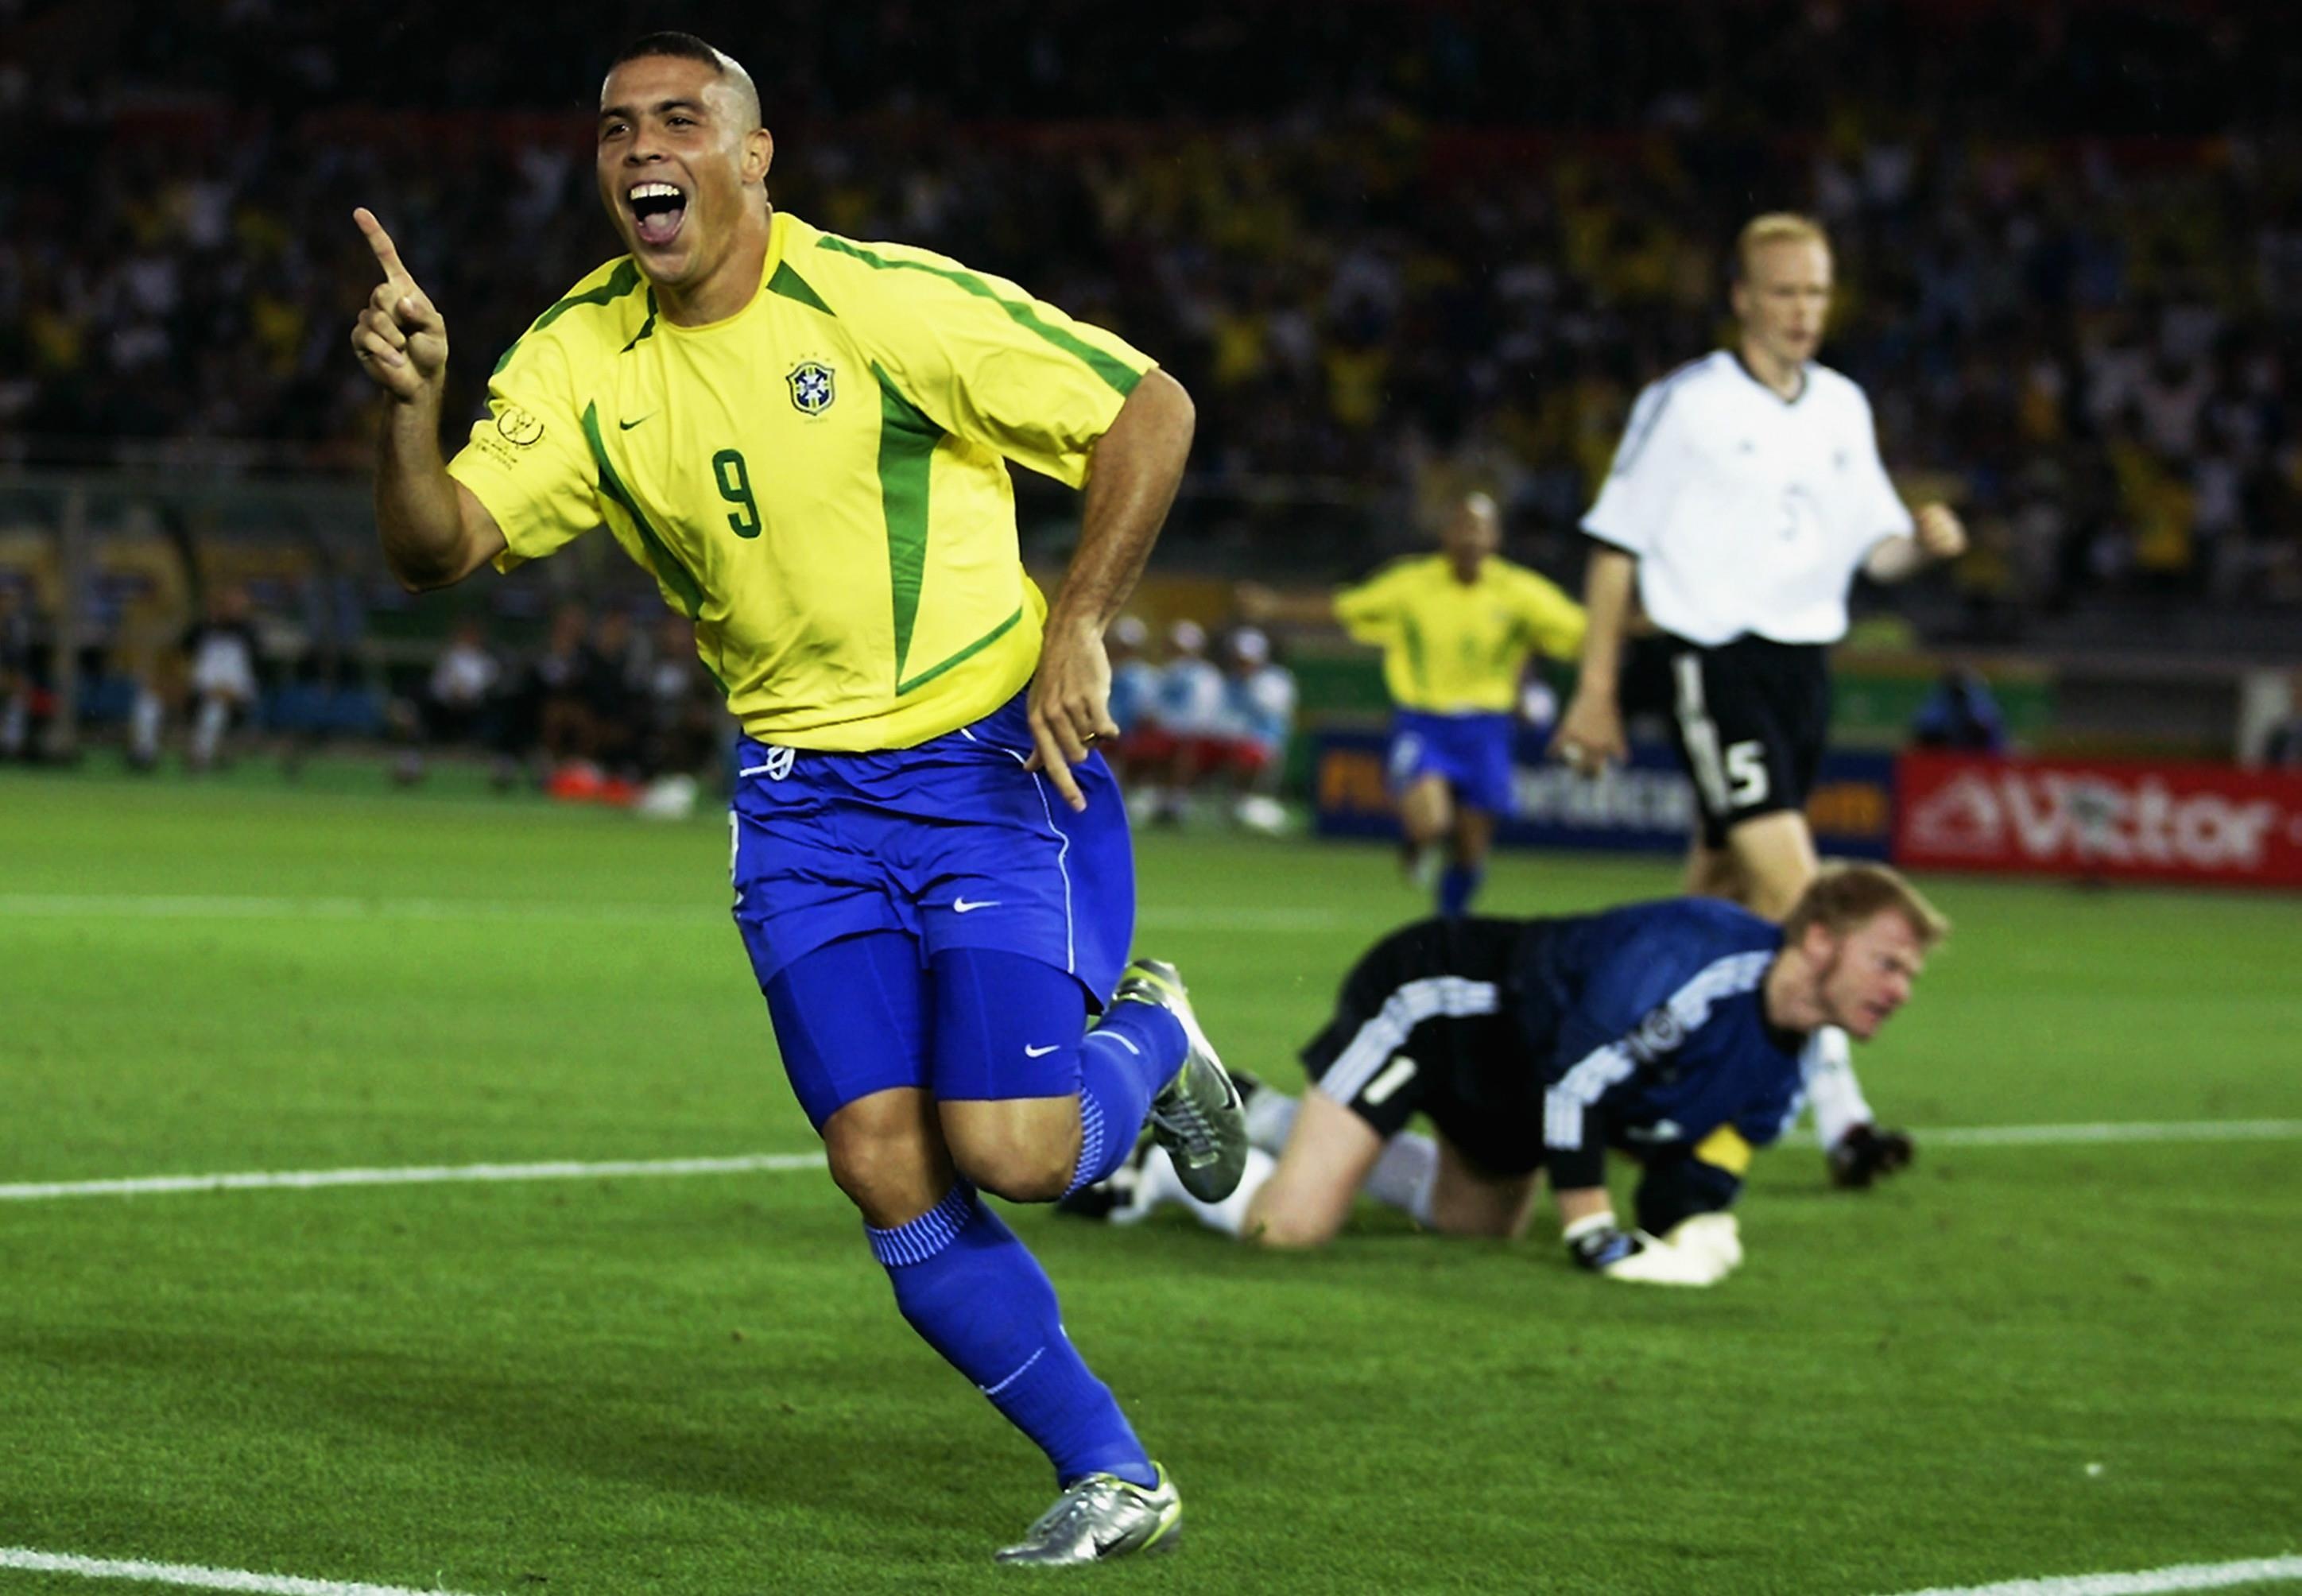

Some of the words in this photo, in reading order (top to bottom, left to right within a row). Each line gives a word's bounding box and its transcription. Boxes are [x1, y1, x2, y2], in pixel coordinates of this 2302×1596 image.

[712, 449, 762, 539] 9
[1728, 741, 1768, 806] 5
[1364, 1056, 1417, 1105] 1
